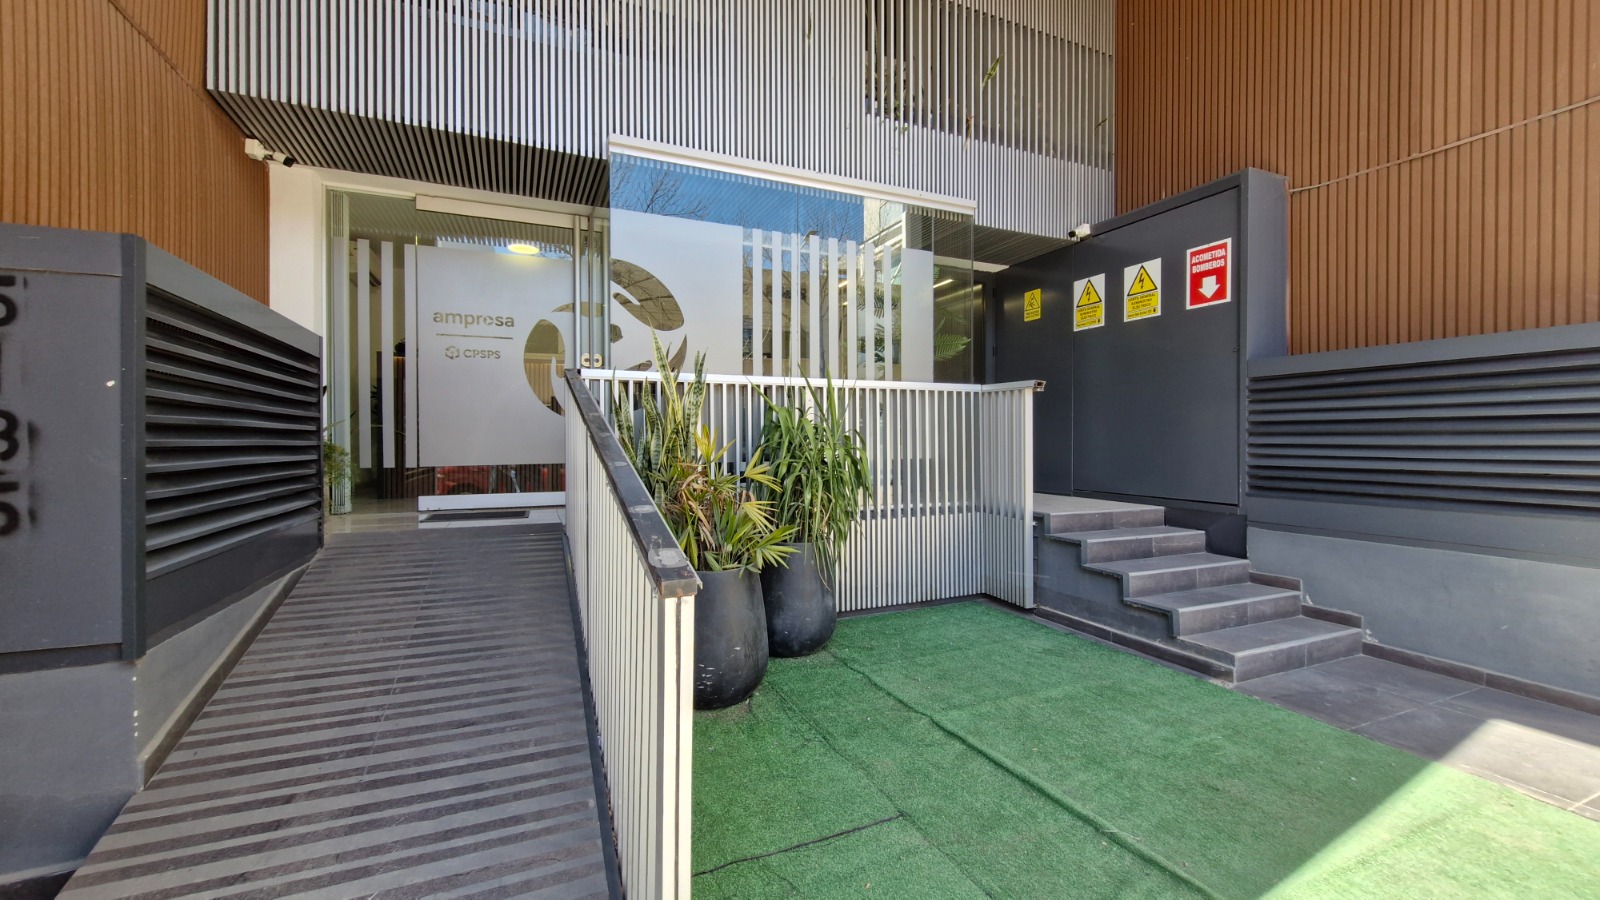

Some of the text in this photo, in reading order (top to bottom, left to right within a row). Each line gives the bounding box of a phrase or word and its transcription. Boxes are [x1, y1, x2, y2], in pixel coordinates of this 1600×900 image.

[1191, 248, 1226, 264] ACOMETIDA
[1192, 258, 1225, 273] BOMBEROS
[433, 312, 514, 329] amprosa
[463, 349, 501, 359] CPSPS
